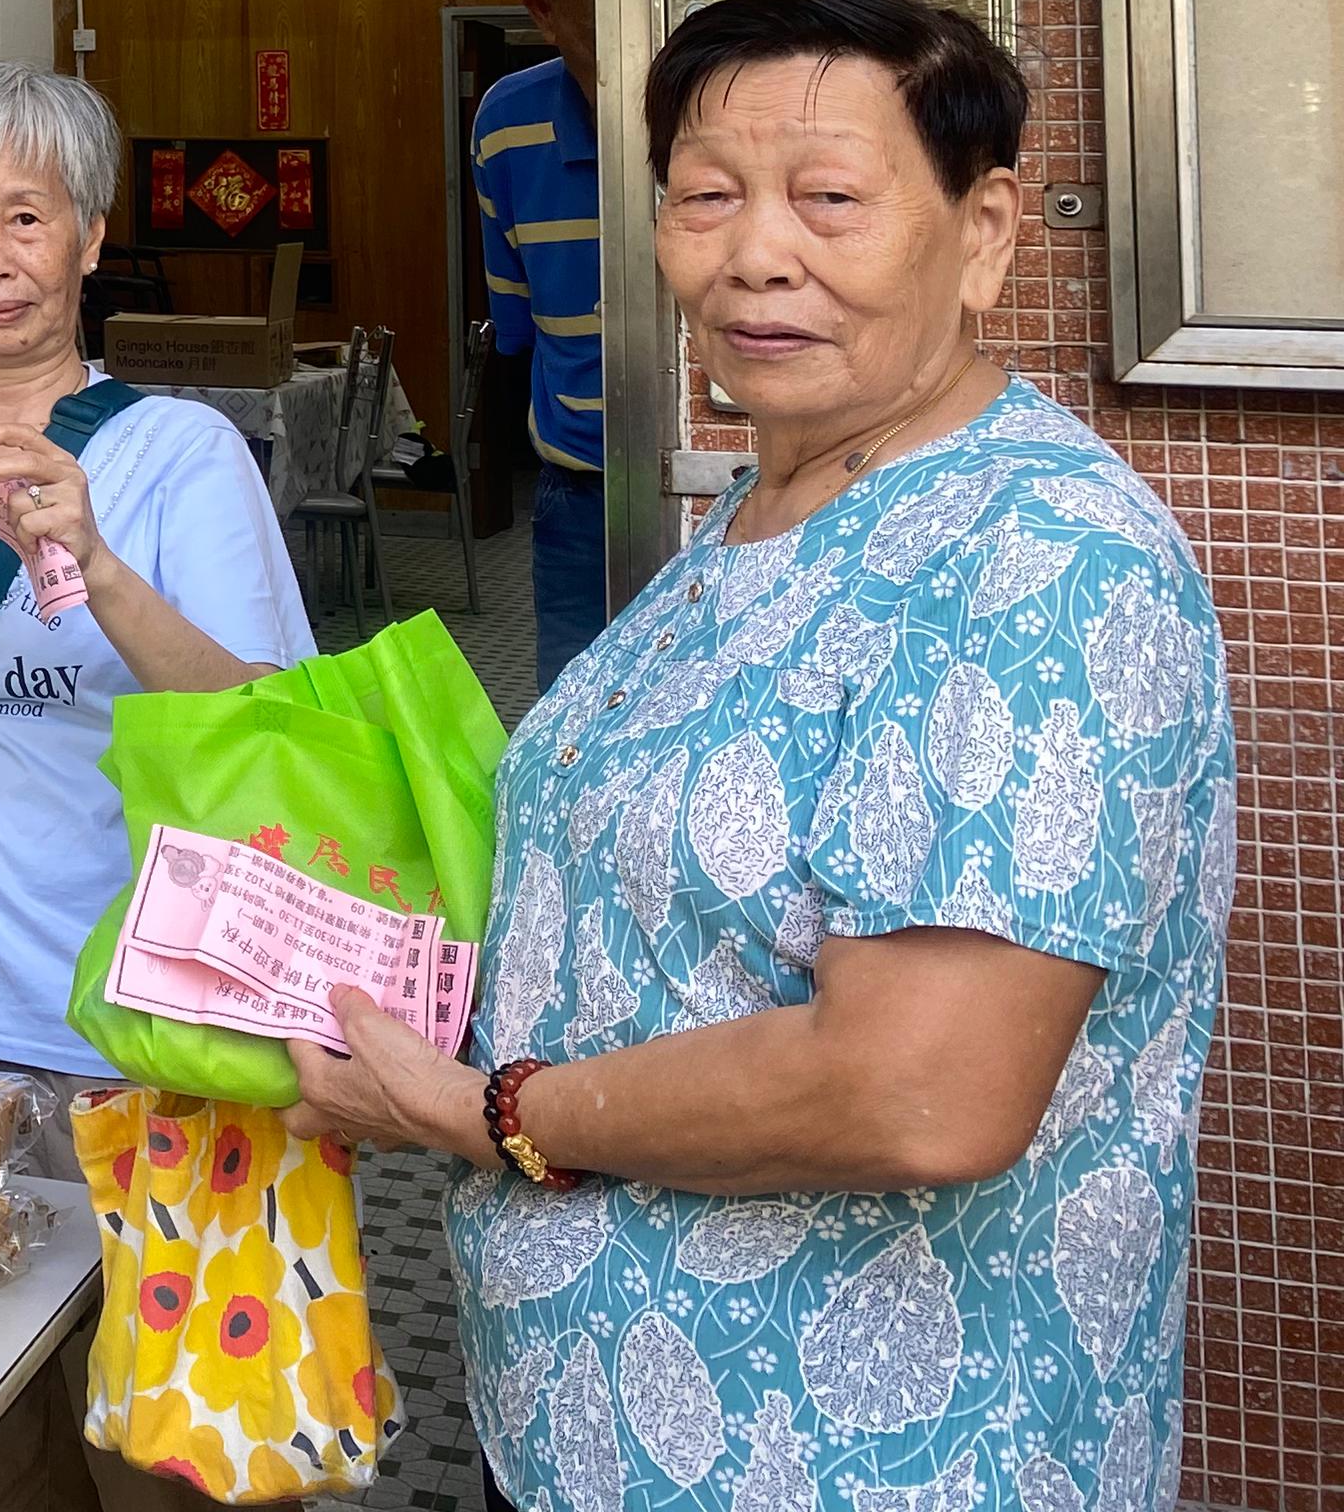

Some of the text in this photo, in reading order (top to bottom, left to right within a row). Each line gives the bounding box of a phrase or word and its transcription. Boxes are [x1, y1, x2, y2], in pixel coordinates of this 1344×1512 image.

[115, 340, 161, 355] Gingko
[166, 341, 209, 354] House
[116, 356, 184, 369] Mooncake
[20, 591, 62, 632] tie
[4, 655, 84, 706] day
